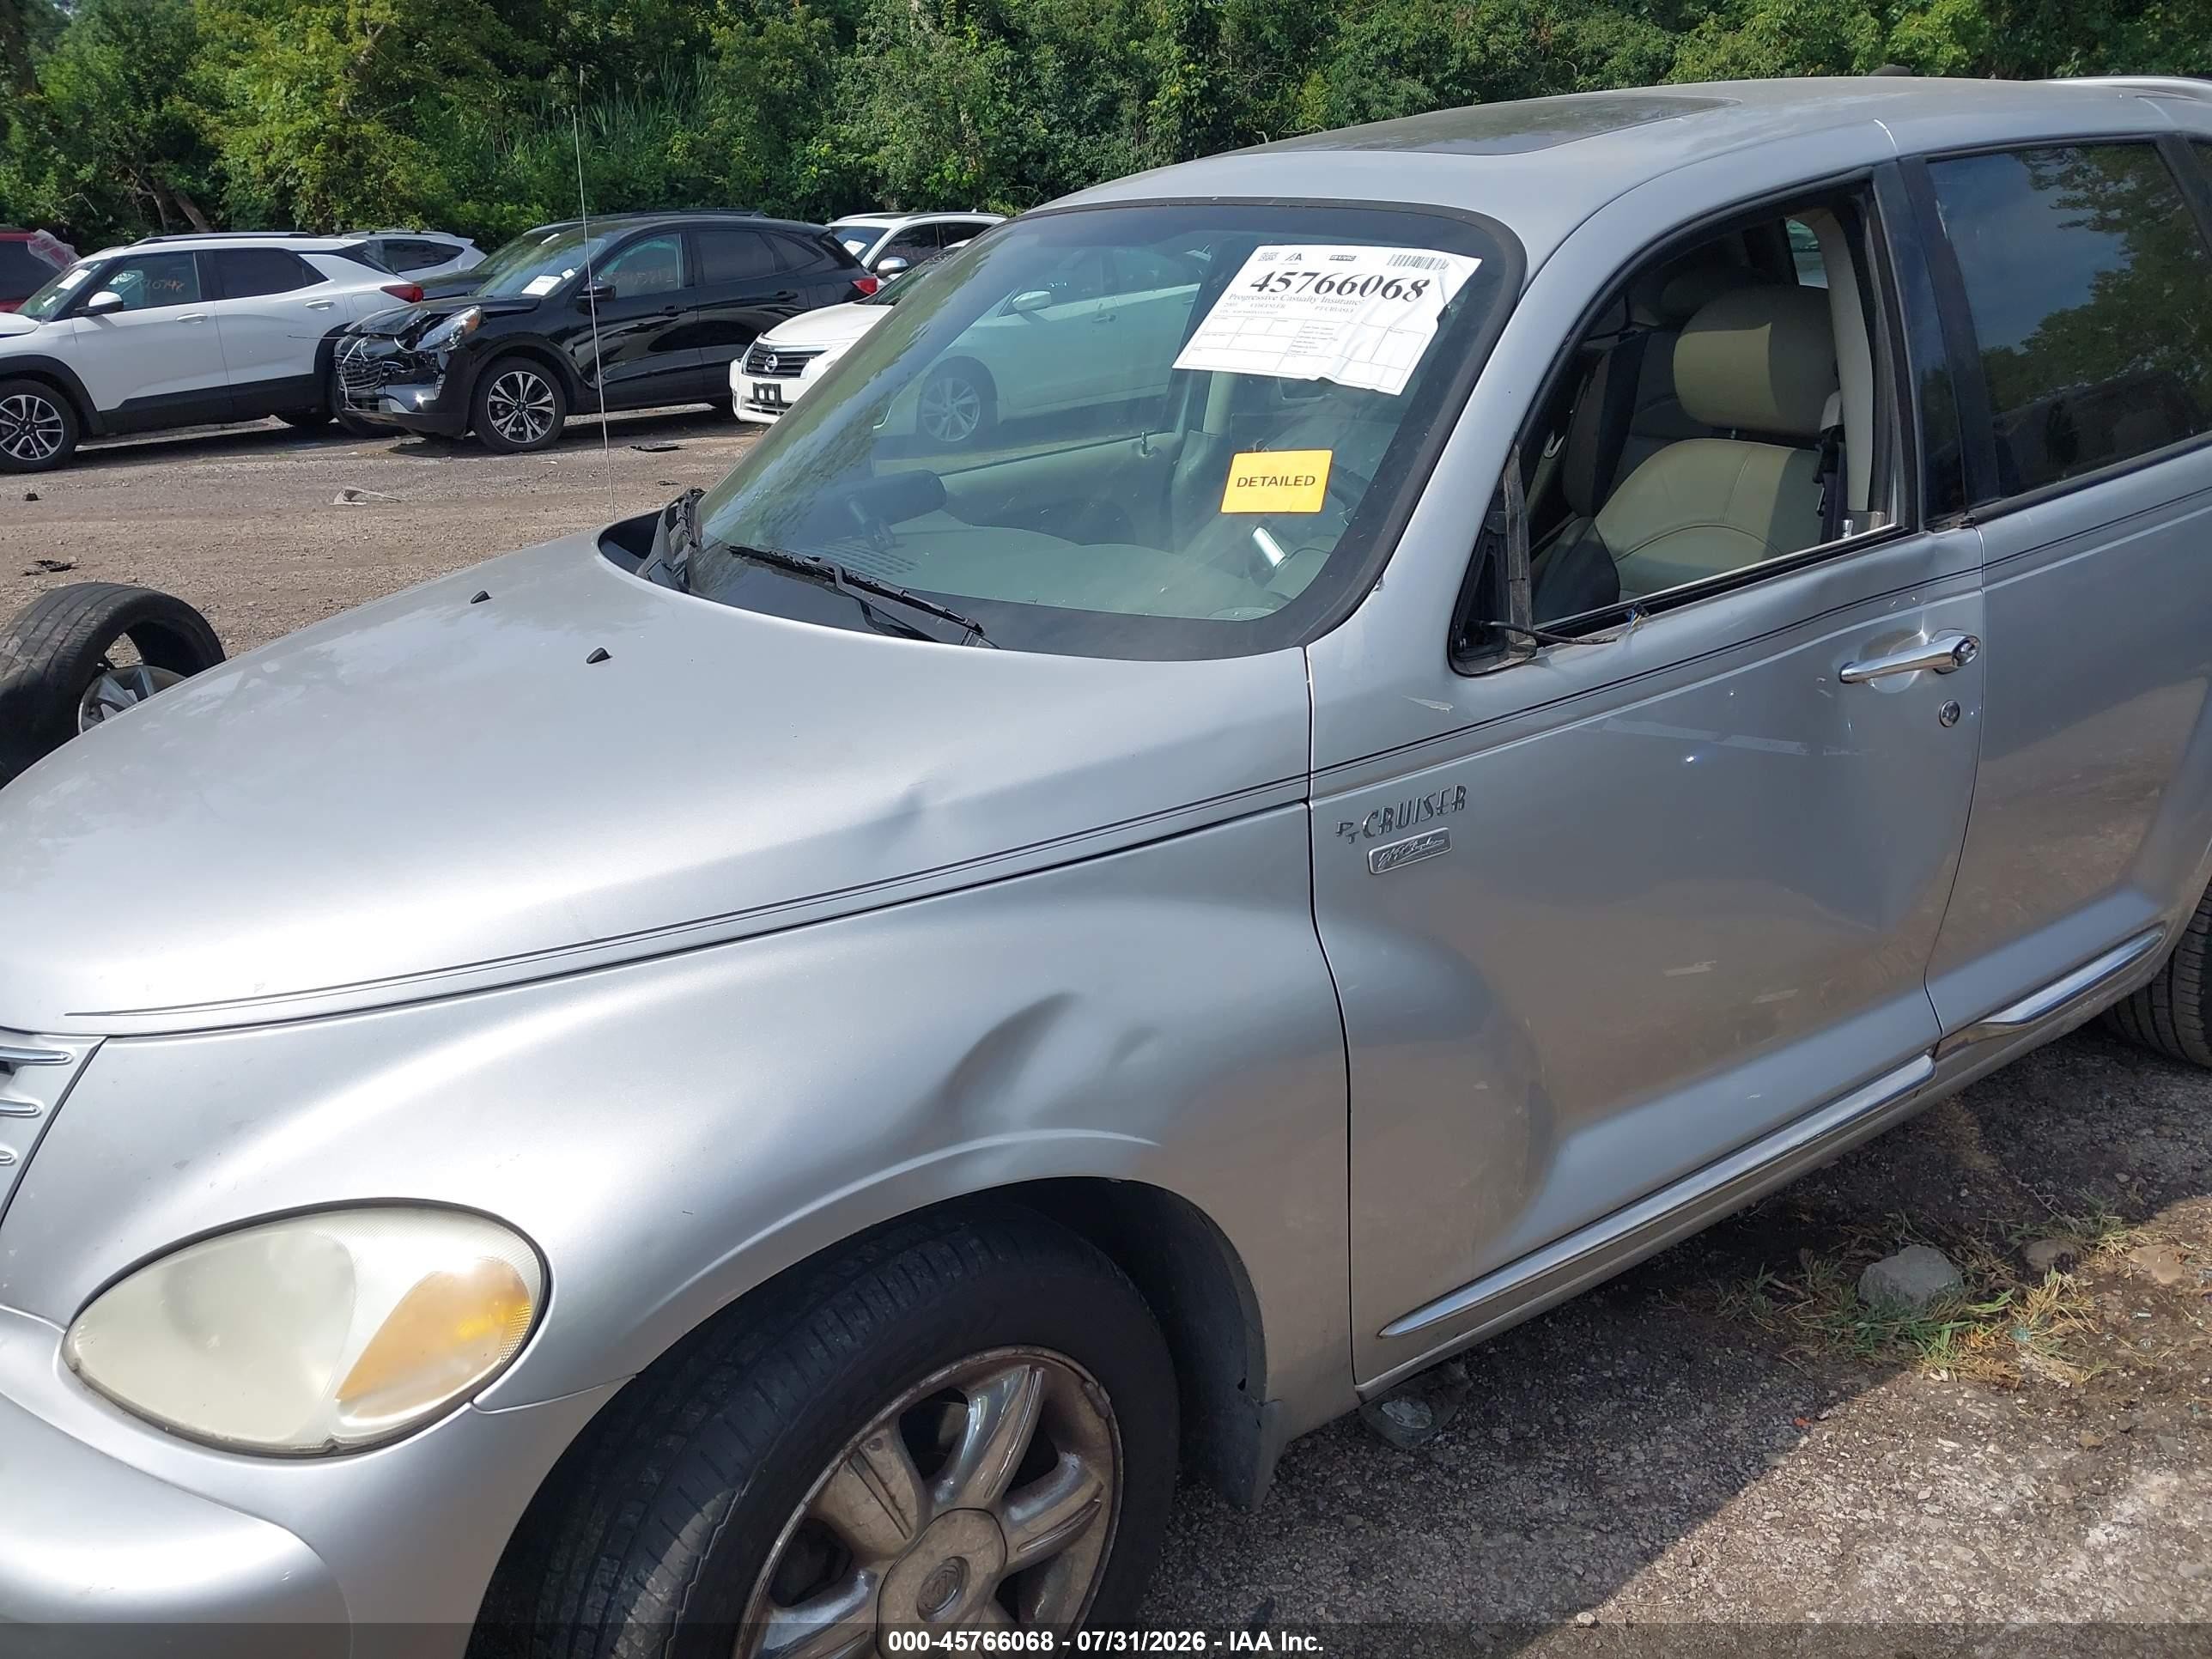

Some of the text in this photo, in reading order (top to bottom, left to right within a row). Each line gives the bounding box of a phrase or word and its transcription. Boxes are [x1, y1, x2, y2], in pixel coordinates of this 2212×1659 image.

[1249, 270, 1431, 301] 45766068
[1228, 293, 1279, 302] Progressive
[1279, 294, 1319, 304] Casualty
[1237, 475, 1316, 488] DETAILED
[1335, 784, 1468, 844] PT CRUISER
